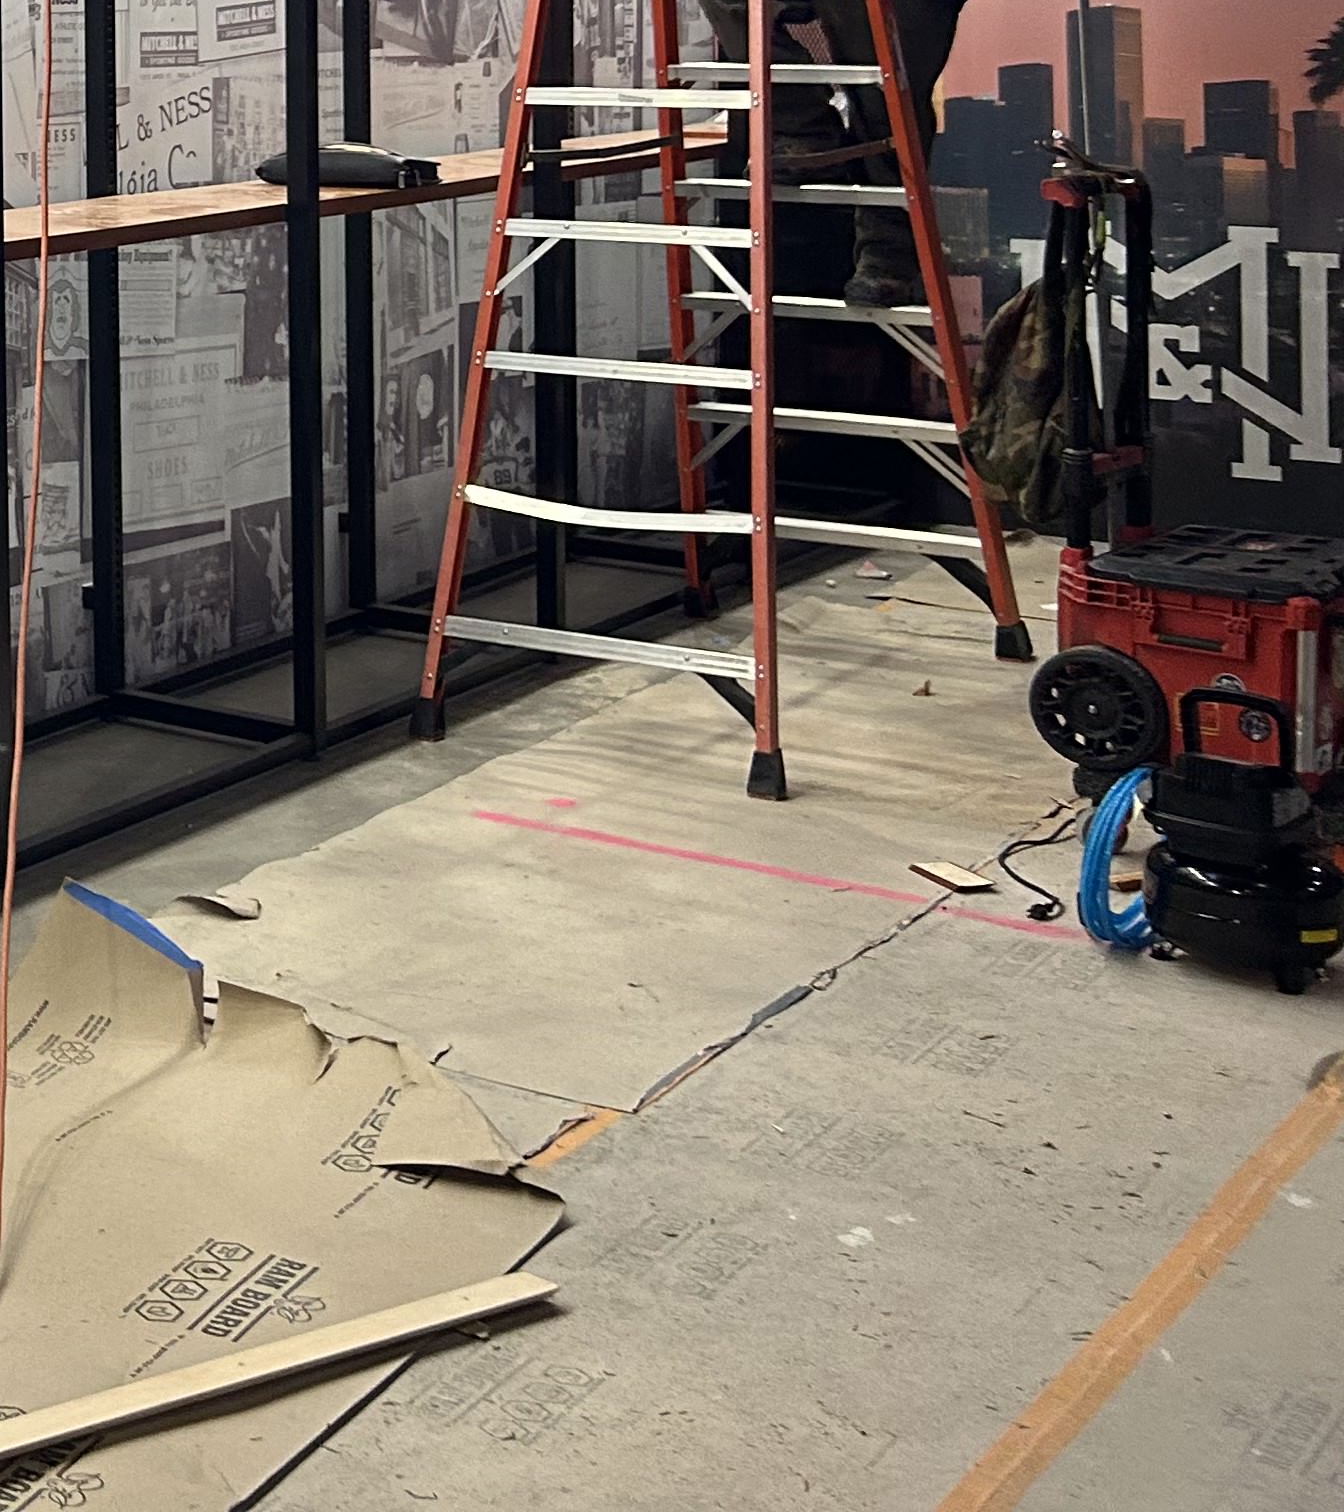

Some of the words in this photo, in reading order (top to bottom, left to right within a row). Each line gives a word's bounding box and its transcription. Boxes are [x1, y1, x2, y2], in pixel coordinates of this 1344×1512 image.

[158, 85, 213, 133] NESS
[254, 1256, 308, 1290] RAM
[200, 1287, 274, 1338] BOARD
